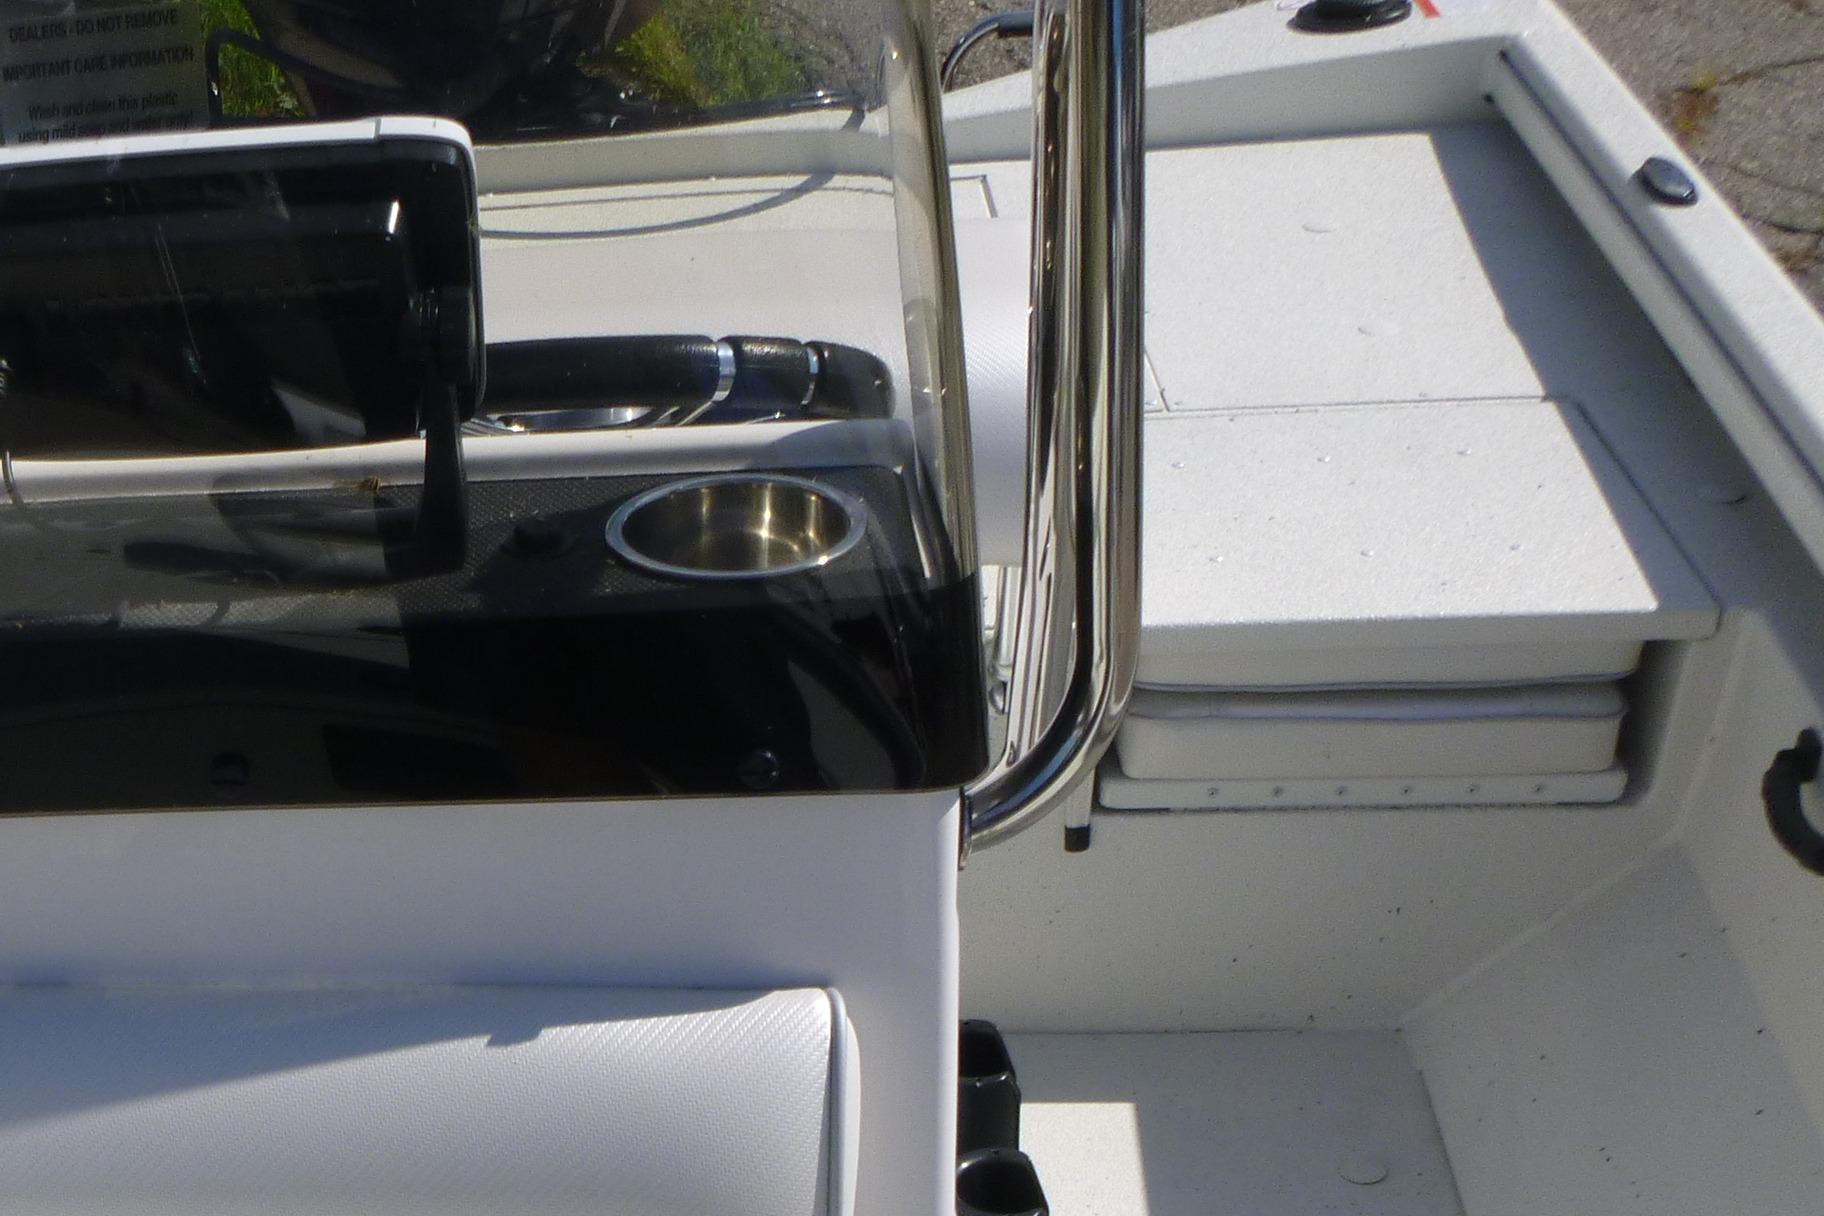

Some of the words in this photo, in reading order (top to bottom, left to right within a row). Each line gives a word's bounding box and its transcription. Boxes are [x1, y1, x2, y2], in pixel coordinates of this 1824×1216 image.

[9, 22, 66, 43] DEALERS
[76, 18, 95, 36] DO
[96, 14, 122, 34] NOT
[125, 8, 178, 30] REMOVE
[2, 59, 72, 82] IMPORTANT
[74, 54, 106, 74] CARE
[109, 46, 194, 70] INFORMATION
[28, 102, 60, 122] Wash
[18, 127, 49, 143] using
[52, 122, 76, 140] mild
